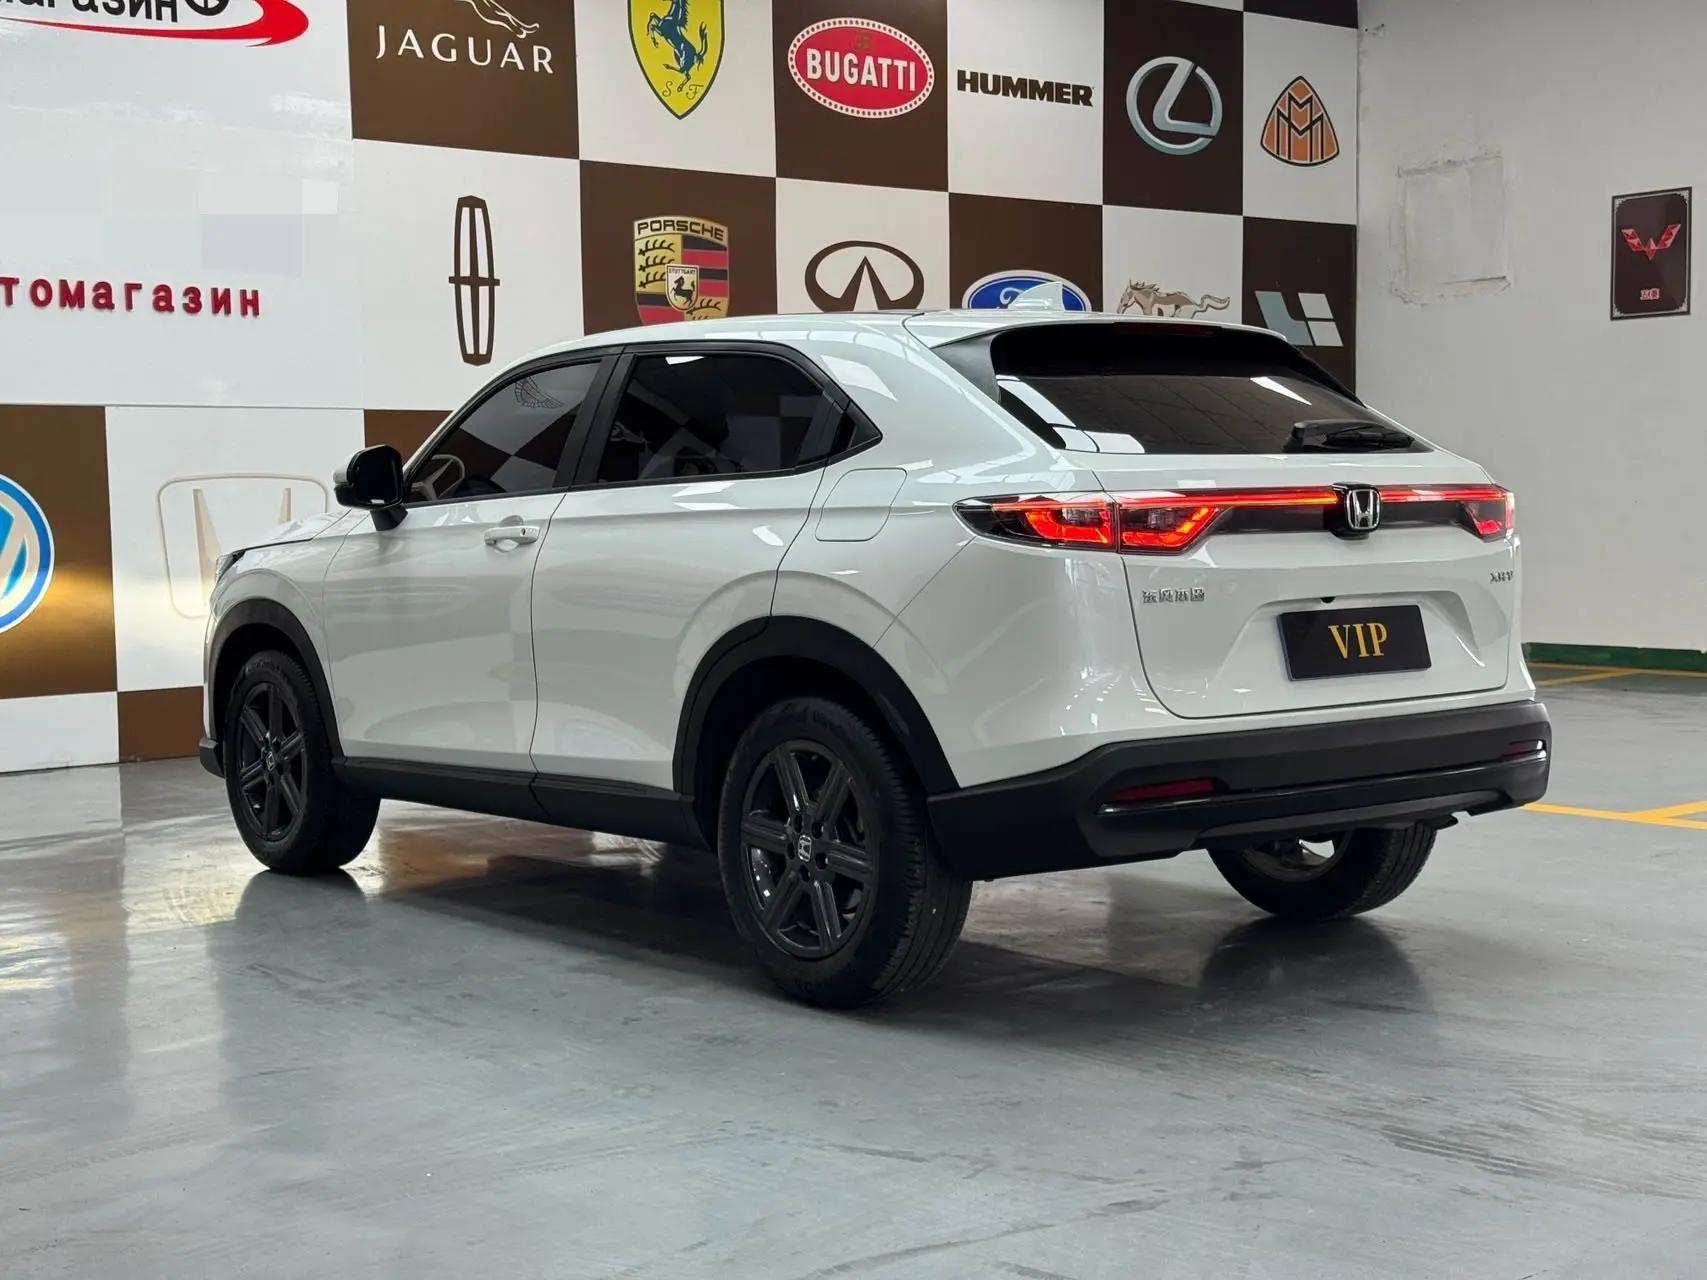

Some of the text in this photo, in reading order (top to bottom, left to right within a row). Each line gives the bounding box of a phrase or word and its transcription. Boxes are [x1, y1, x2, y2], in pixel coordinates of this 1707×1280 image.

[376, 25, 554, 74] JAGUAR
[806, 47, 916, 91] BUGATTI
[957, 69, 1093, 107] HUMMER
[637, 219, 724, 241] PORSCHE
[0, 277, 260, 317] томагазин
[1328, 622, 1387, 659] VIP
